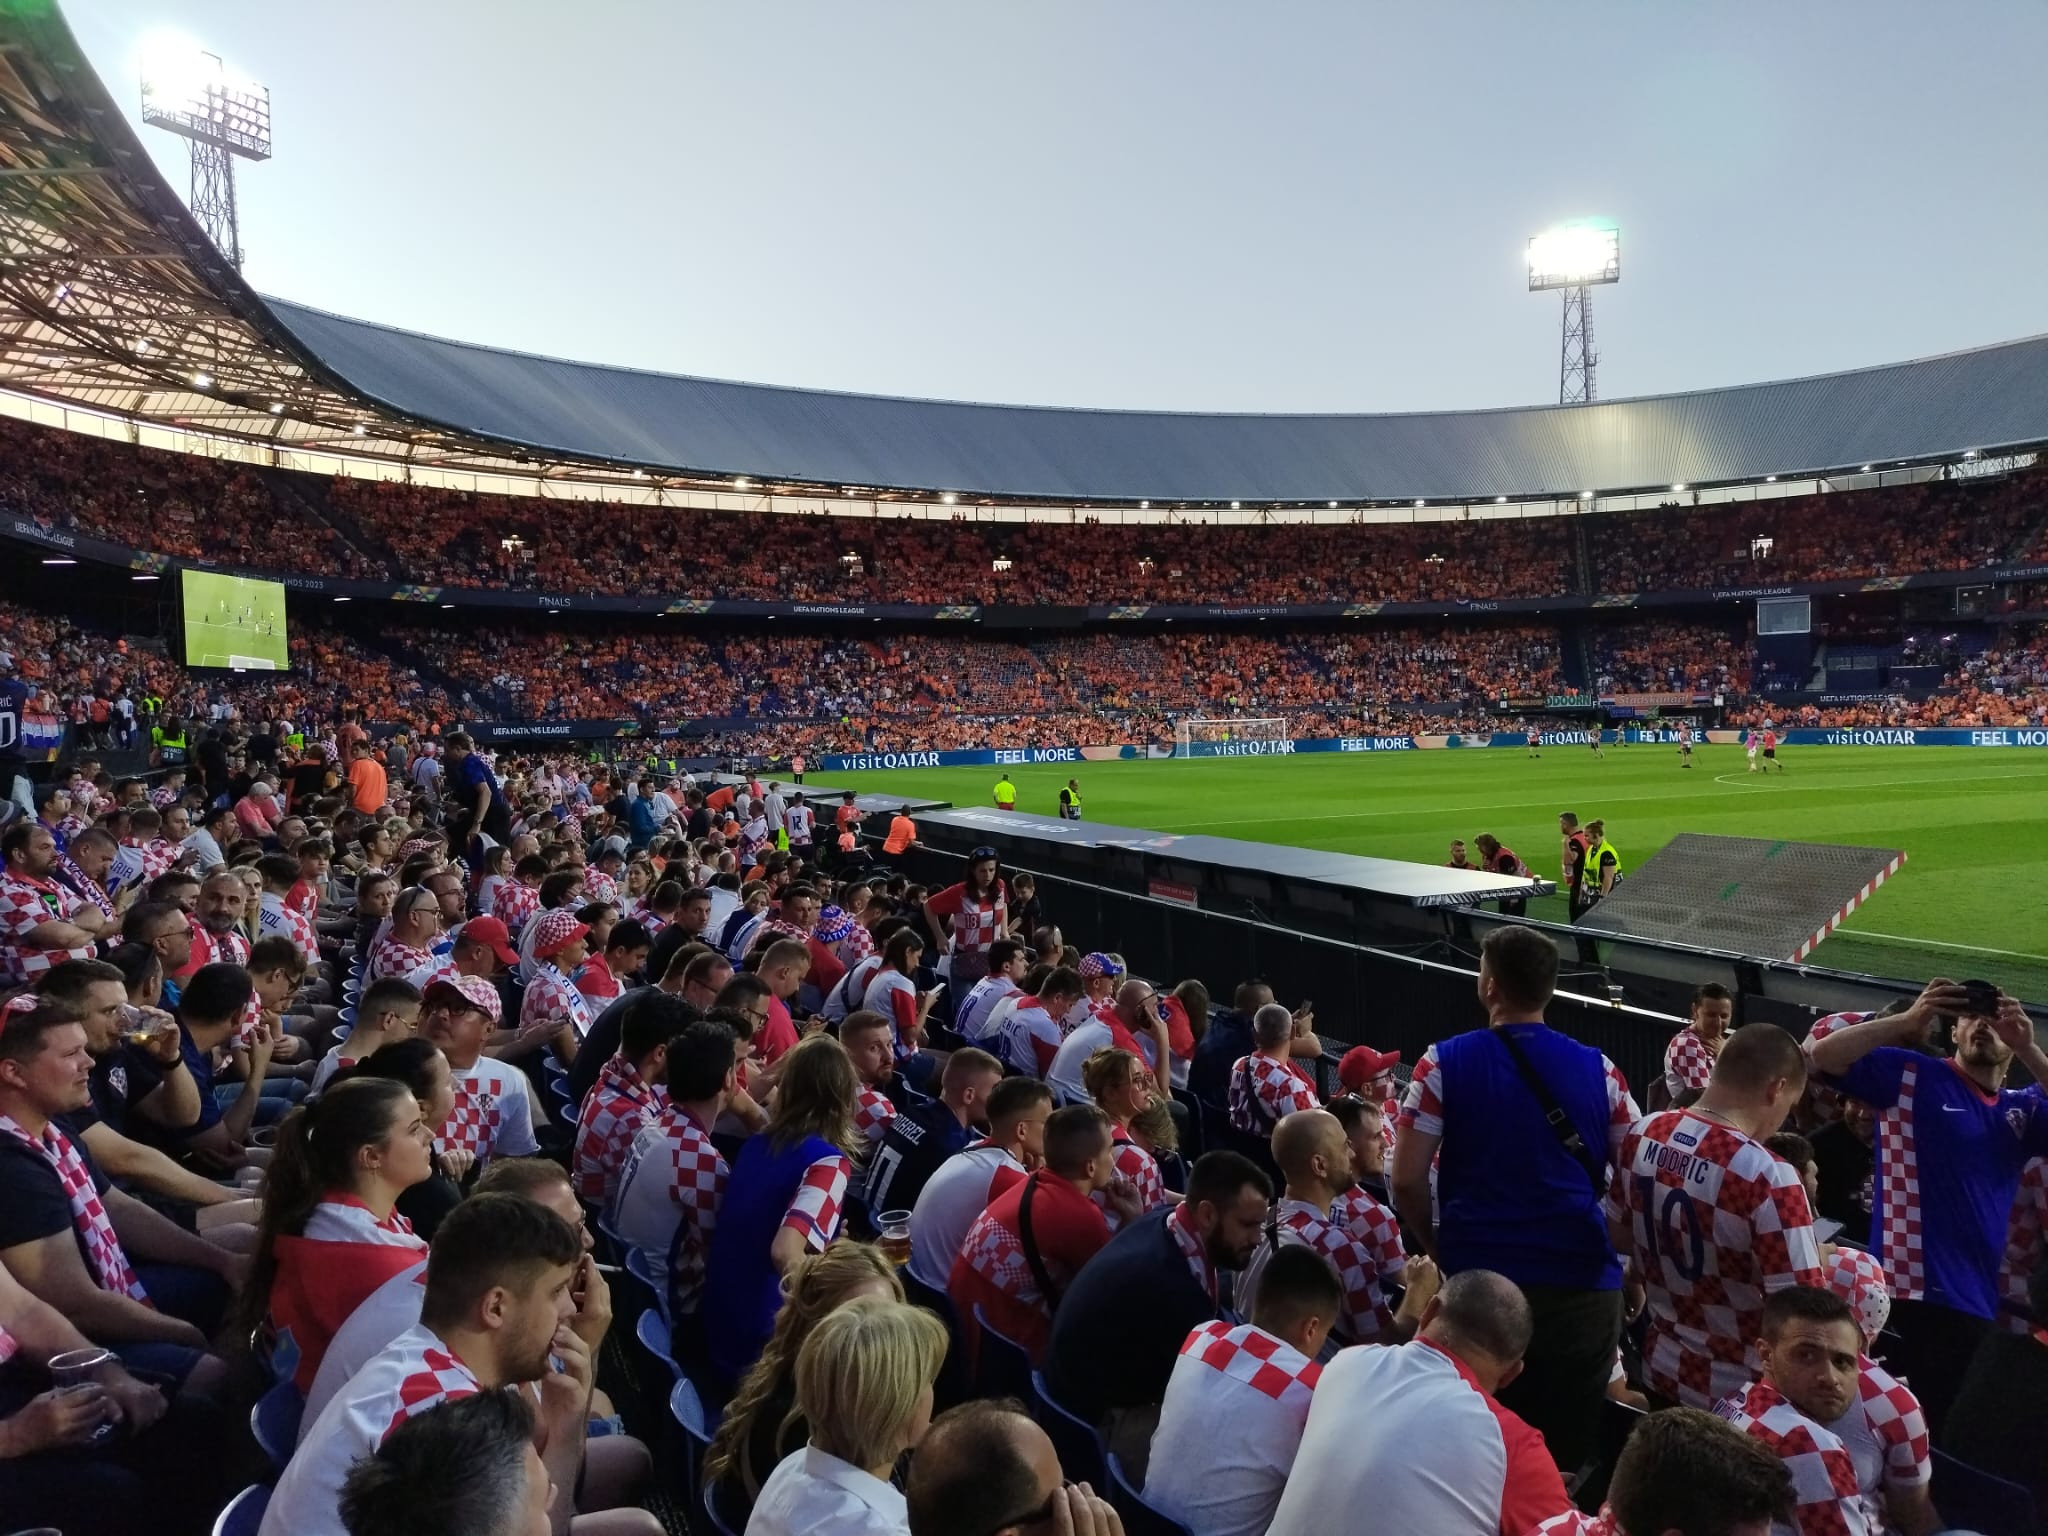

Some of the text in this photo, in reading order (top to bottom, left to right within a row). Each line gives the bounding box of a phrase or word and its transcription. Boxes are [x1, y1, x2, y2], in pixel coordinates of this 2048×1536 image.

[1763, 587, 1792, 595] LEAGUE
[538, 596, 571, 607] FINALS
[1470, 602, 1498, 611] FINALS
[810, 606, 840, 614] NATIONS
[492, 727, 511, 735] UEFA
[542, 726, 571, 734] LEAGUE
[1341, 737, 1410, 751] FEEL MORE
[1972, 731, 2012, 745] FEEL
[994, 747, 1076, 764] FEEL MORE
[1643, 1140, 1710, 1184] MODRIĆ
[1636, 1175, 1705, 1281] 10
